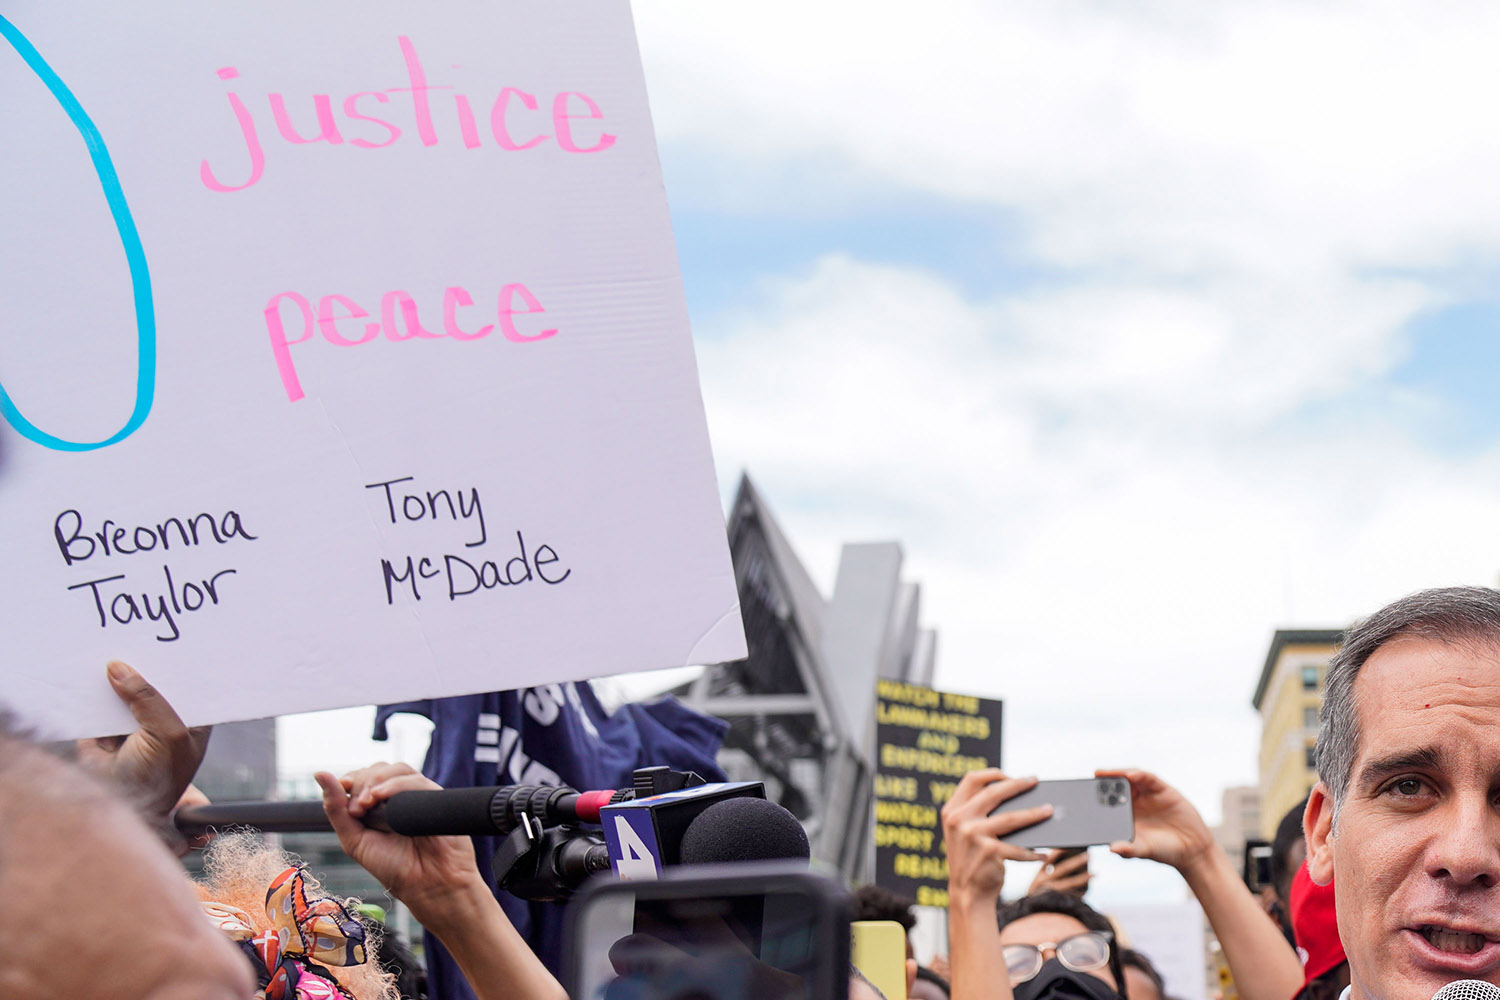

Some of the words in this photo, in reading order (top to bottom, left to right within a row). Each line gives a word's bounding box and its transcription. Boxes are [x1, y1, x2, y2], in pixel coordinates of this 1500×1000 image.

[200, 34, 618, 193] justice
[264, 282, 559, 403] peace
[54, 509, 258, 570] Breonna
[365, 476, 487, 548] Tony
[67, 560, 238, 643] Taylor
[380, 530, 572, 606] McDade
[877, 701, 990, 740] LAWMAKERS
[917, 730, 960, 754] AND
[875, 774, 918, 801] LIKE
[614, 815, 659, 880] 4
